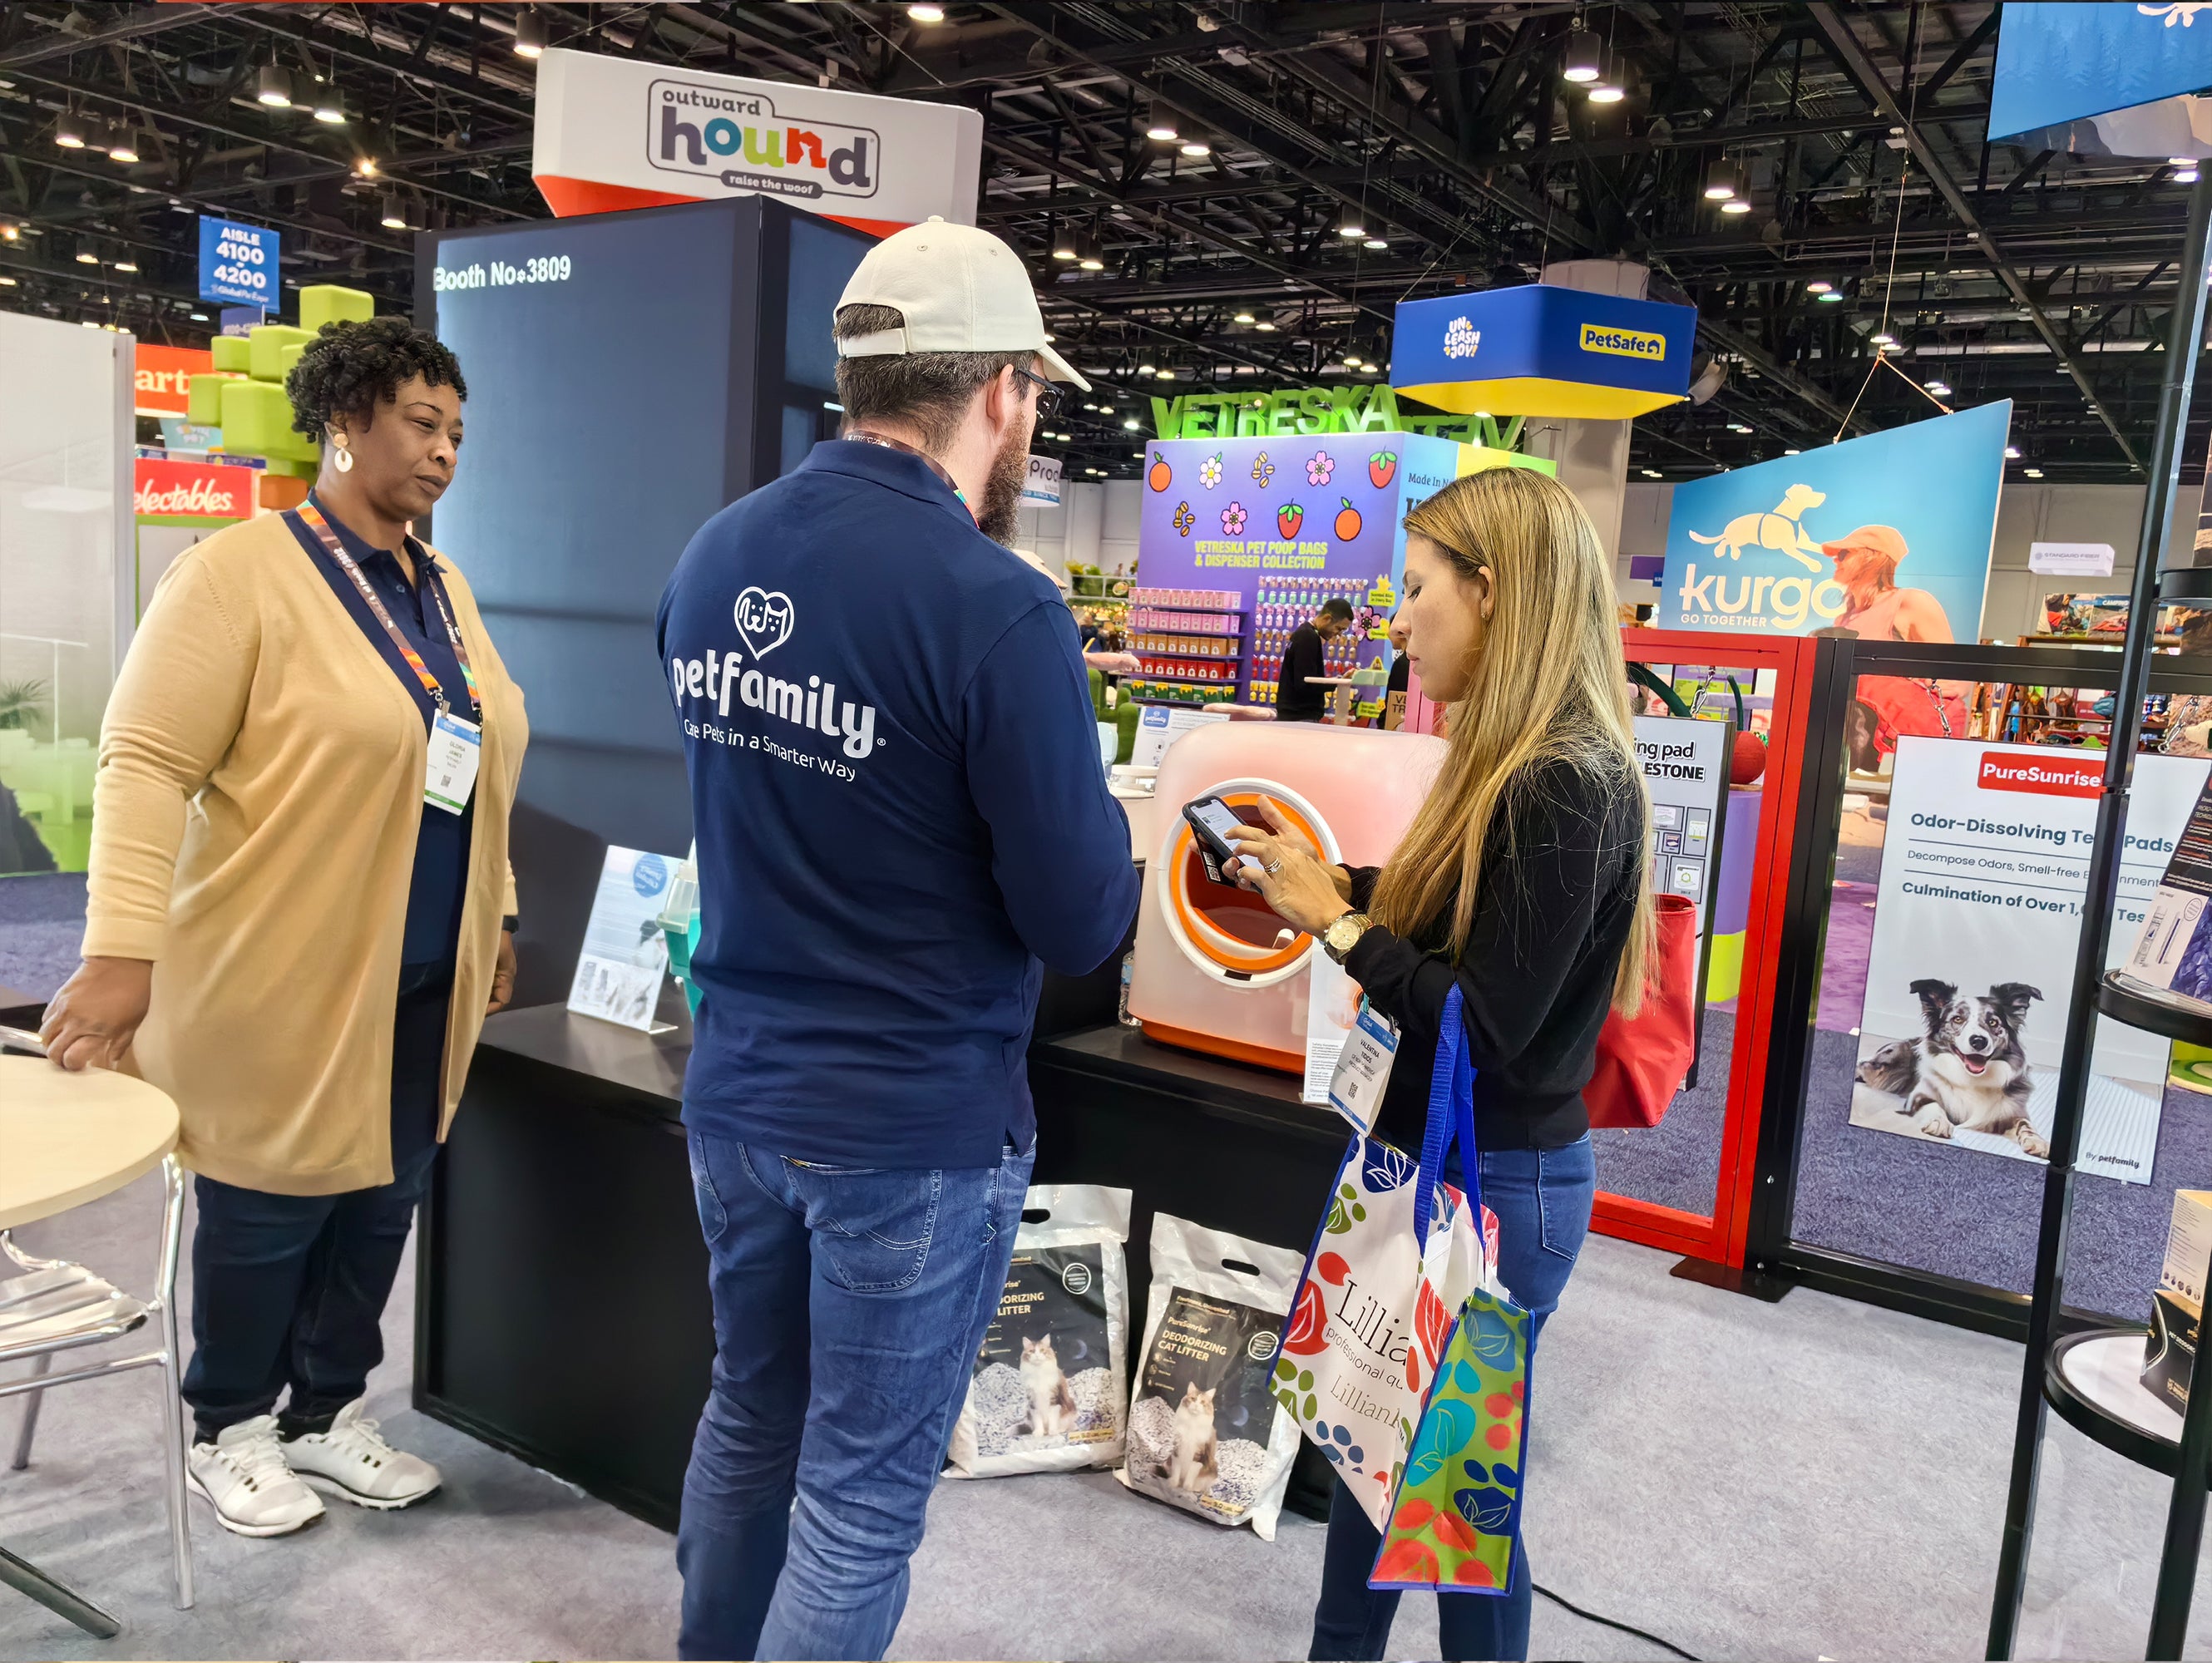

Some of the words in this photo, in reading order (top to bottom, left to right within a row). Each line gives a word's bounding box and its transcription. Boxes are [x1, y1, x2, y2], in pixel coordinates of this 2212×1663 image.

[662, 90, 761, 116] outward
[661, 105, 871, 188] hound
[729, 175, 759, 187] raise
[761, 178, 782, 191] the
[783, 181, 814, 195] woof
[220, 227, 260, 245] AISLE
[216, 241, 264, 265] 4100
[213, 264, 266, 289] 4200
[432, 264, 486, 291] Booth
[1444, 330, 1481, 345] LEASH
[1585, 329, 1646, 353] PetSafe
[1450, 343, 1479, 359] JOY!
[1151, 383, 1404, 440] VETRESKA
[1408, 472, 1431, 486] Made
[1432, 476, 1440, 487] In
[1195, 540, 1244, 554] VETRESKA
[1247, 541, 1266, 555] PET
[1268, 541, 1296, 555] POOP
[1299, 542, 1328, 555] BAGS
[1195, 555, 1202, 567] &
[1205, 555, 1260, 568] DISPENSER
[1262, 555, 1326, 569] COLLECTION
[1679, 564, 1847, 629] kurgo
[1681, 614, 1700, 624] GO
[1703, 614, 1767, 627] TOGETHER
[684, 718, 699, 738] Care
[703, 723, 724, 744] Pets
[728, 728, 744, 747] in
[748, 736, 759, 749] a
[763, 736, 815, 769] Smarter
[817, 756, 856, 782] Way
[1634, 738, 1658, 760] ing
[1661, 742, 1696, 762] pad
[1982, 763, 2101, 788] PureSunrise
[1911, 812, 2066, 846] Odor-Dissolving
[2072, 830, 2095, 845] Te
[2124, 835, 2174, 853] Pads
[1908, 850, 1976, 868] Decompose
[1978, 857, 2015, 873] Odors,
[2018, 862, 2081, 879] Smell-free
[1902, 882, 2002, 906] Culmination
[2006, 895, 2022, 909] of
[2025, 897, 2066, 914] Over
[2086, 1152, 2096, 1162] By
[2098, 1154, 2140, 1169] petfamily
[998, 1305, 1031, 1315] LITTER
[1158, 1340, 1177, 1353] CAT
[1176, 1345, 1210, 1362] LITTER
[1163, 1330, 1227, 1356] DEODORIZING
[1326, 1327, 1385, 1379] professional
